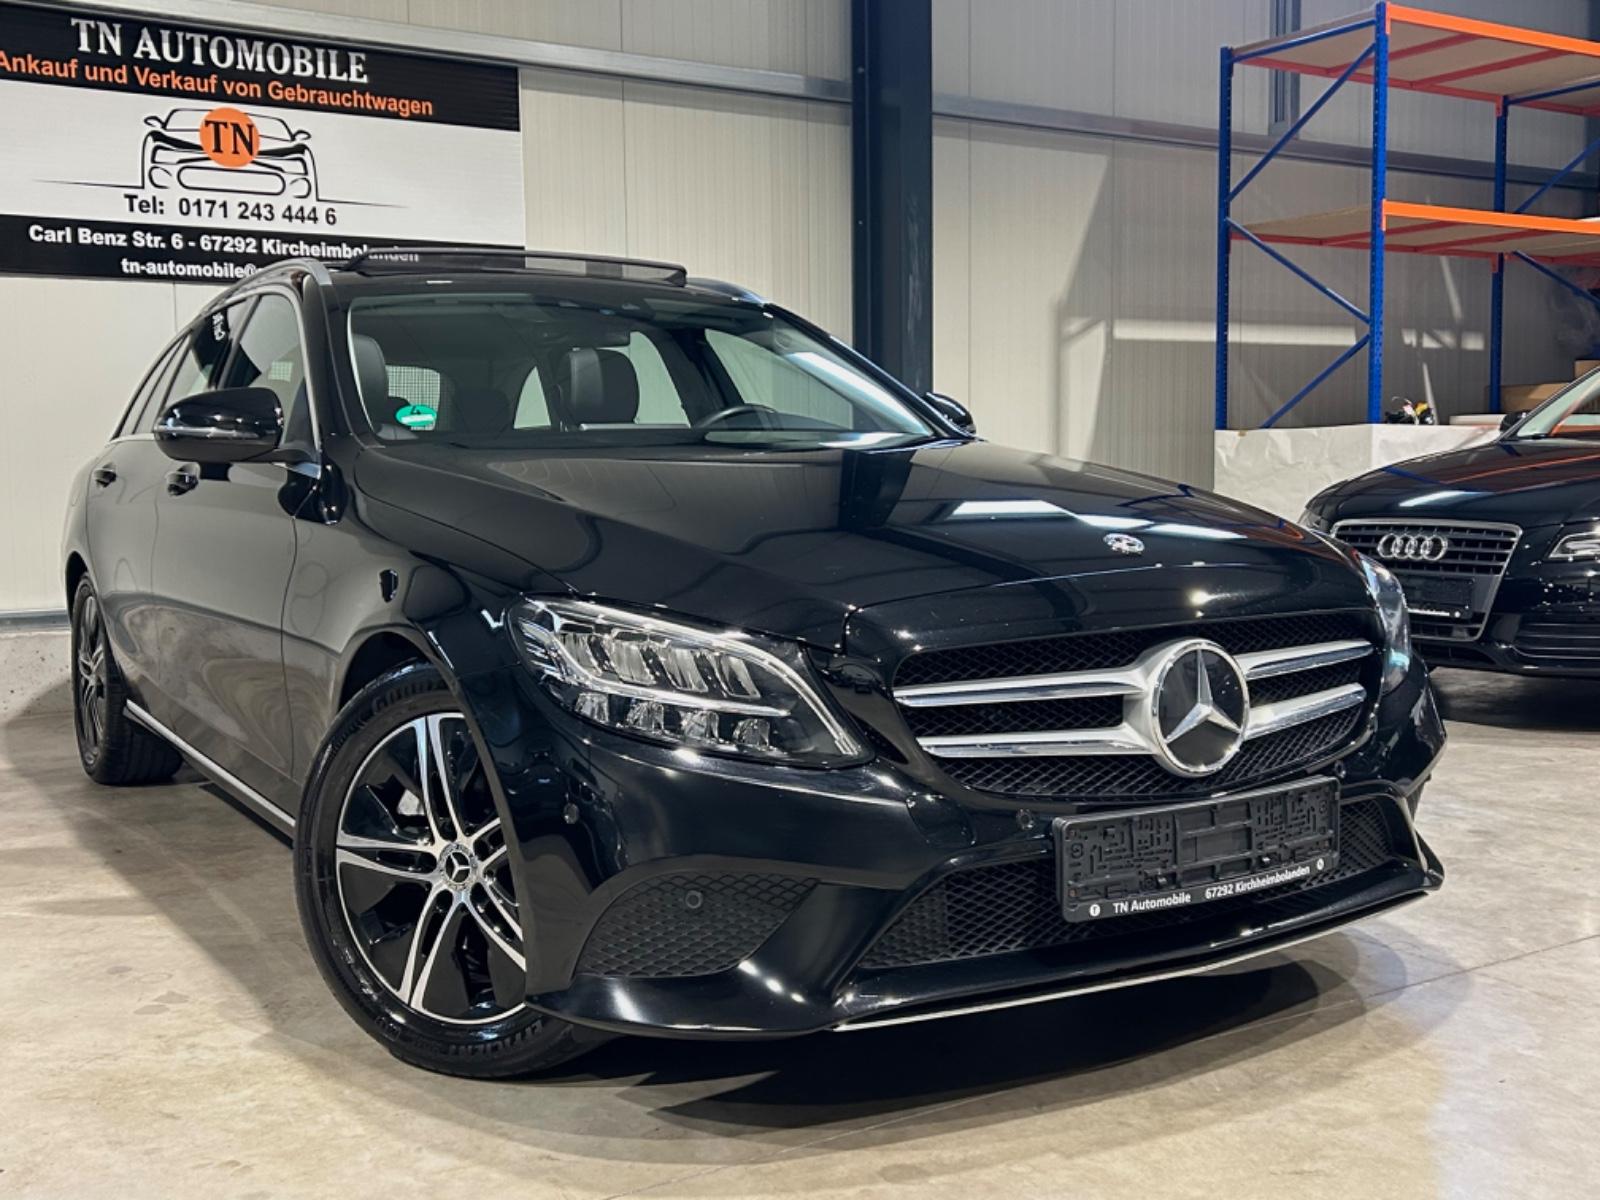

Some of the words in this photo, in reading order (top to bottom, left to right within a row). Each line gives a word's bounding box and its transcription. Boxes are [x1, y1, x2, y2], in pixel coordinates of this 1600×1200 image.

[70, 17, 122, 56] TN
[133, 26, 368, 84] AUTOMOBILE
[0, 50, 78, 78] Ankauf
[85, 65, 127, 84] und
[134, 65, 218, 93] Verkauf
[223, 80, 261, 98] von
[267, 81, 433, 117] Gebrauchtwagen
[204, 119, 254, 156] TN
[124, 194, 164, 214] Tel:
[179, 198, 228, 219] 0171
[237, 201, 275, 222] 243
[282, 205, 318, 225] 444
[325, 207, 337, 226] 6
[29, 224, 72, 244] Carl
[77, 228, 128, 247] Benz
[132, 231, 167, 249] Str.
[171, 233, 184, 250] 6
[200, 234, 257, 254] 67292
[120, 258, 265, 280] tn-automobile@
[1113, 901, 1129, 914] TN
[1131, 892, 1191, 912] Automobile
[1205, 884, 1234, 899] 67292
